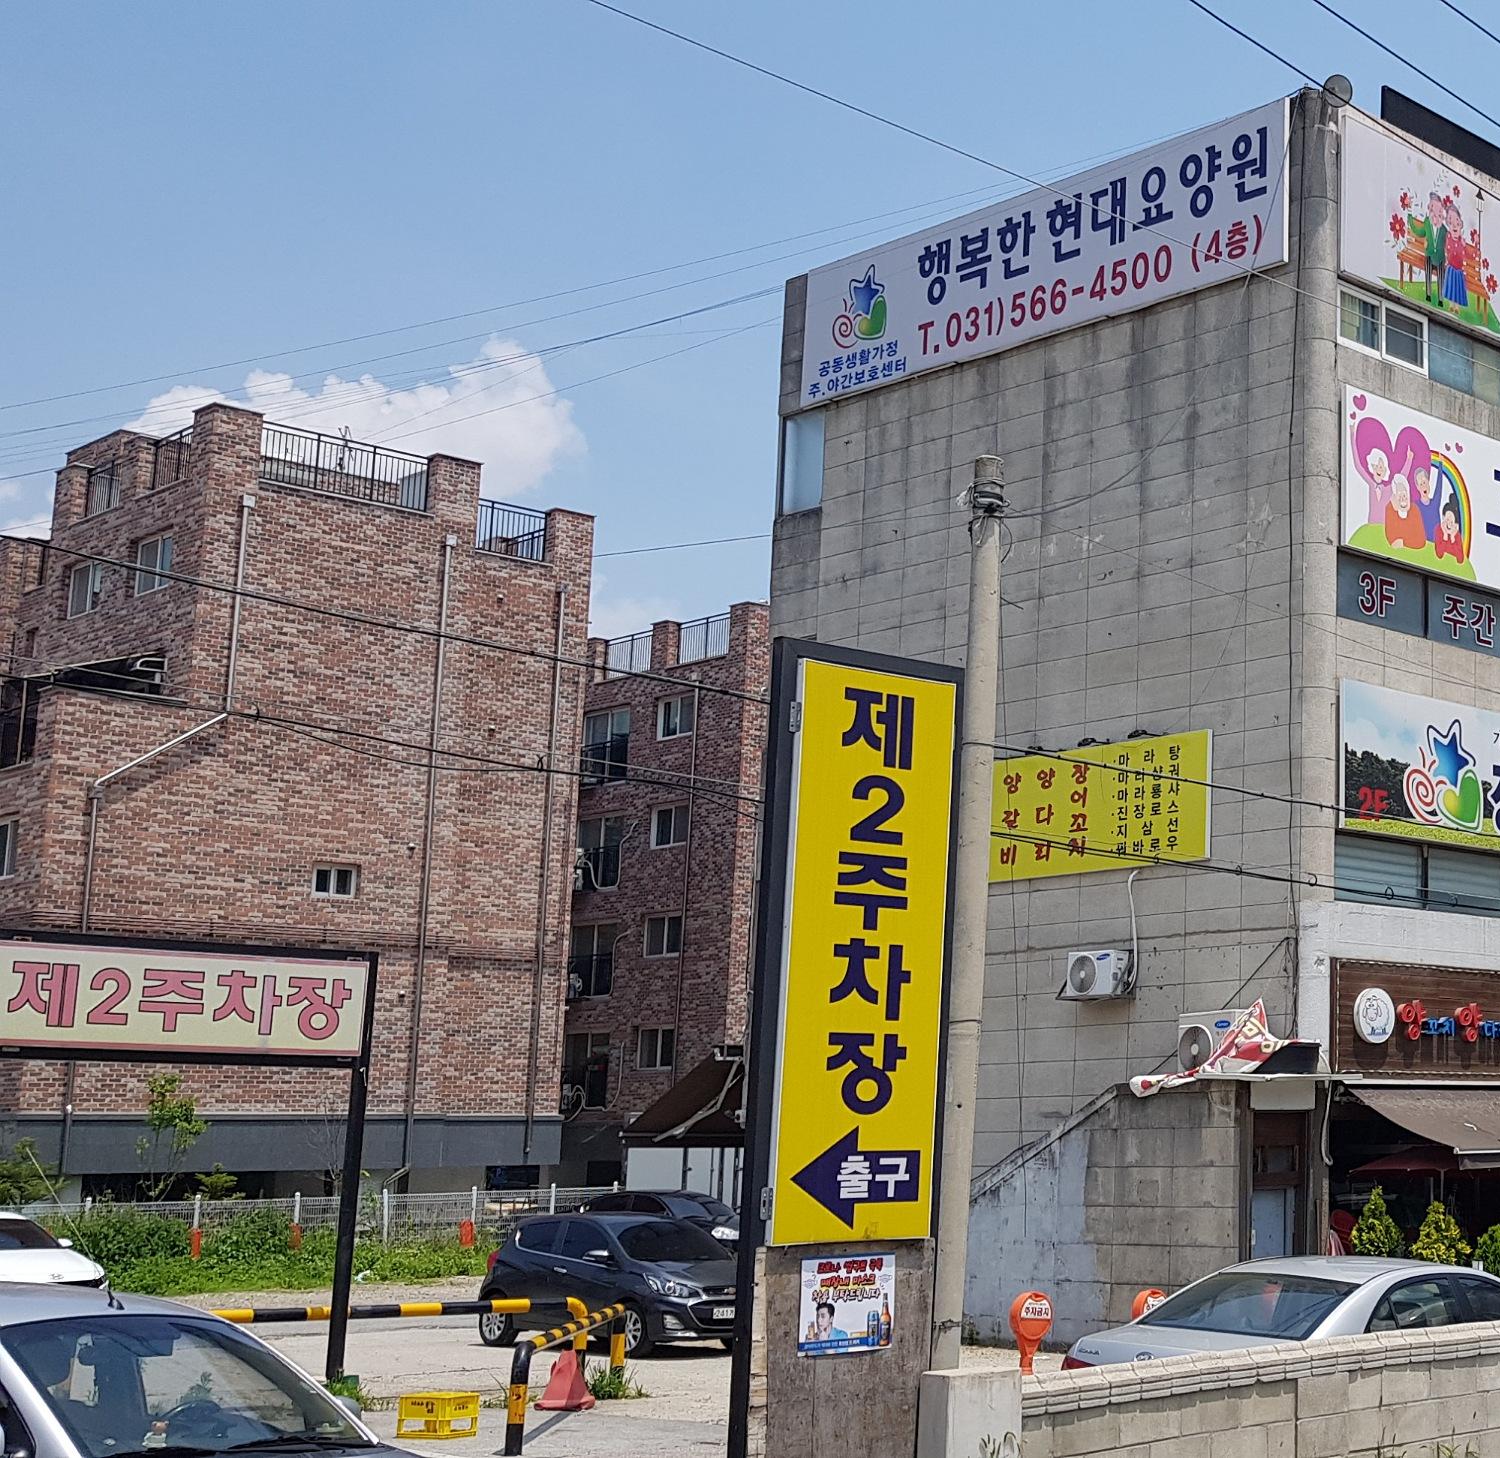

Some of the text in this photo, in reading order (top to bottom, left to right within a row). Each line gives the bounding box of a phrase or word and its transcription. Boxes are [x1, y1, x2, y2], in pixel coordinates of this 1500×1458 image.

[918, 125, 1269, 305] 행복한 현대요양원
[918, 214, 1263, 356] T.031)566-4500 (4층)
[818, 339, 898, 377] 공동생활가정
[1359, 571, 1396, 617] 3F
[1442, 594, 1496, 648] 주간
[826, 686, 915, 1117] 제2주차장
[8, 961, 352, 1040] 제2주차장
[835, 1154, 910, 1201] 출구
